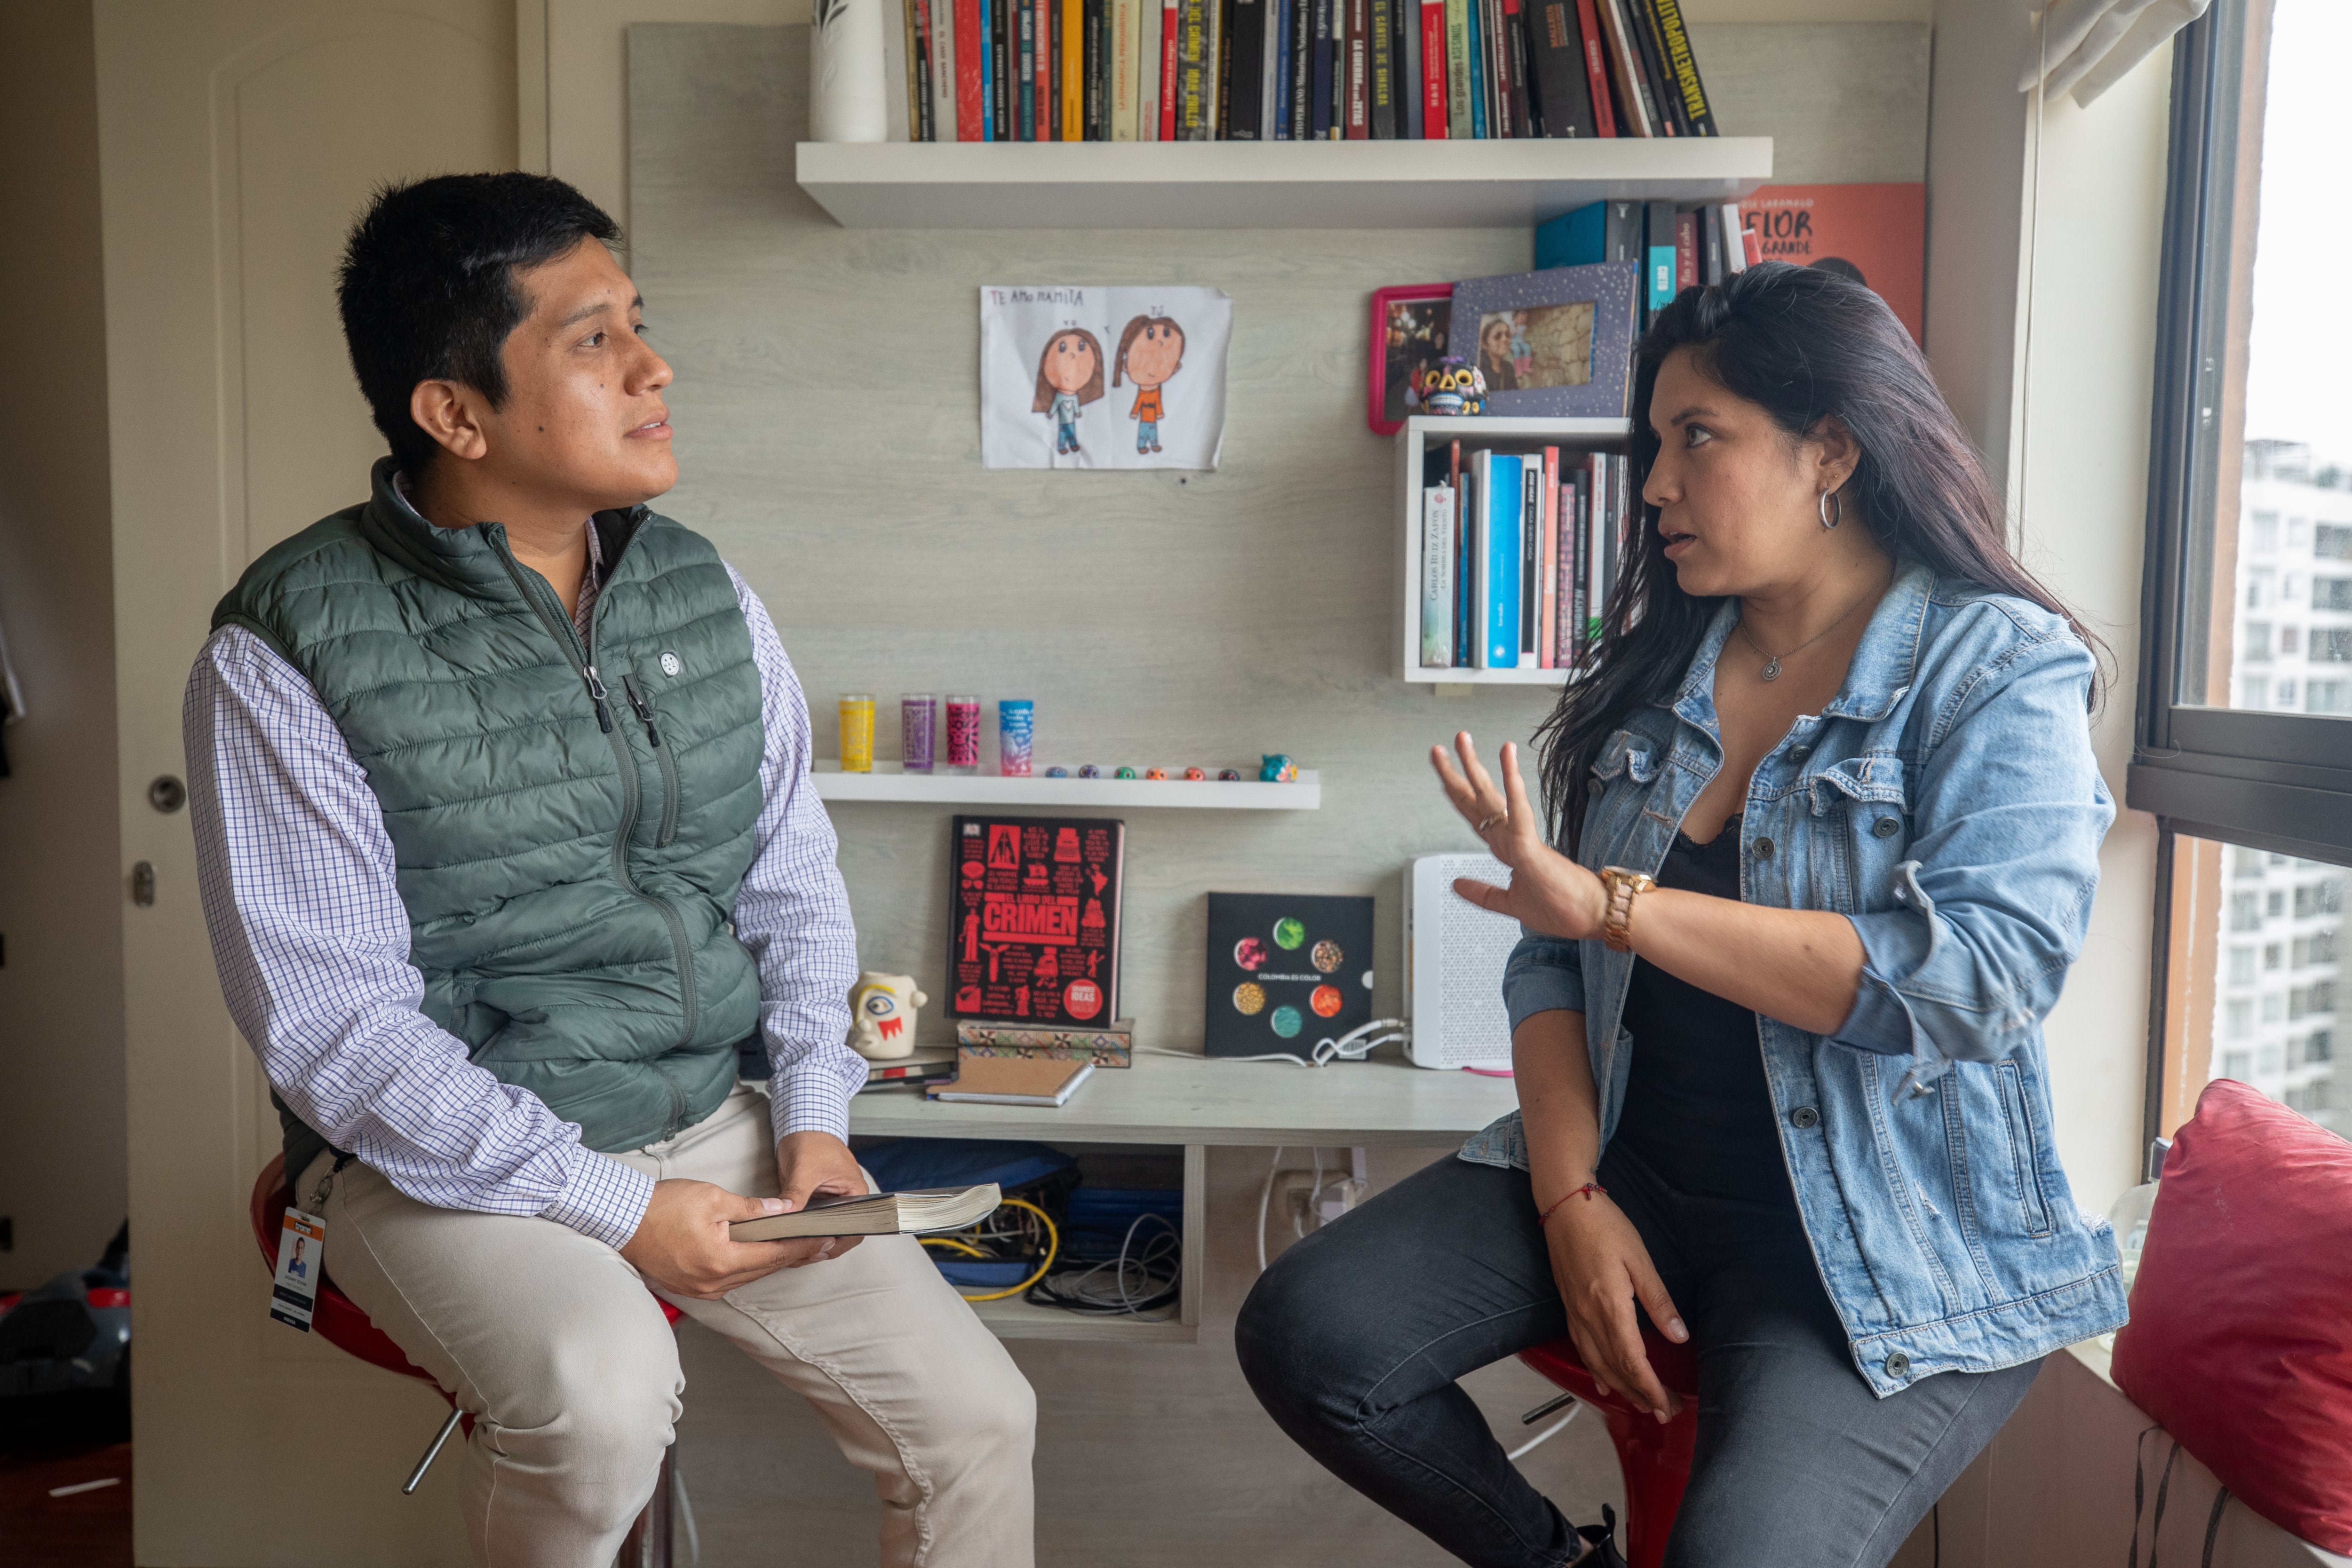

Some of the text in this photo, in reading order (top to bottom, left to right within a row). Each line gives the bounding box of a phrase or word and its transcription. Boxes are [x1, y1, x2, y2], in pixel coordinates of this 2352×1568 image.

[1375, 1, 1386, 12] EL
[1187, 7, 1201, 61] DEL CRIMEN
[1353, 40, 1363, 50] LA
[1376, 53, 1387, 64] DE
[1353, 51, 1363, 84] GUERRA
[1451, 23, 1465, 116] Los grandes ASESINOS
[1376, 69, 1388, 106] SINALOA
[1119, 102, 1125, 111] LA
[1352, 100, 1363, 126] ZETAS
[1761, 198, 1813, 208] SARAMAGO
[1746, 210, 1813, 238] FLOR
[1679, 223, 1691, 247] cabo
[1680, 249, 1691, 257] al
[1762, 241, 1811, 254] GRANDE
[990, 290, 1006, 306] TE
[1430, 509, 1439, 601] CARLOS RUIZ ZAFÓN
[1440, 579, 1447, 589] LA
[664, 659, 677, 668] MAUI
[1005, 894, 1057, 904] EL LIBRO DEL
[984, 902, 1078, 936] CRIMEN
[1072, 992, 1095, 1002] IDEAS
[294, 1222, 312, 1235] trome
